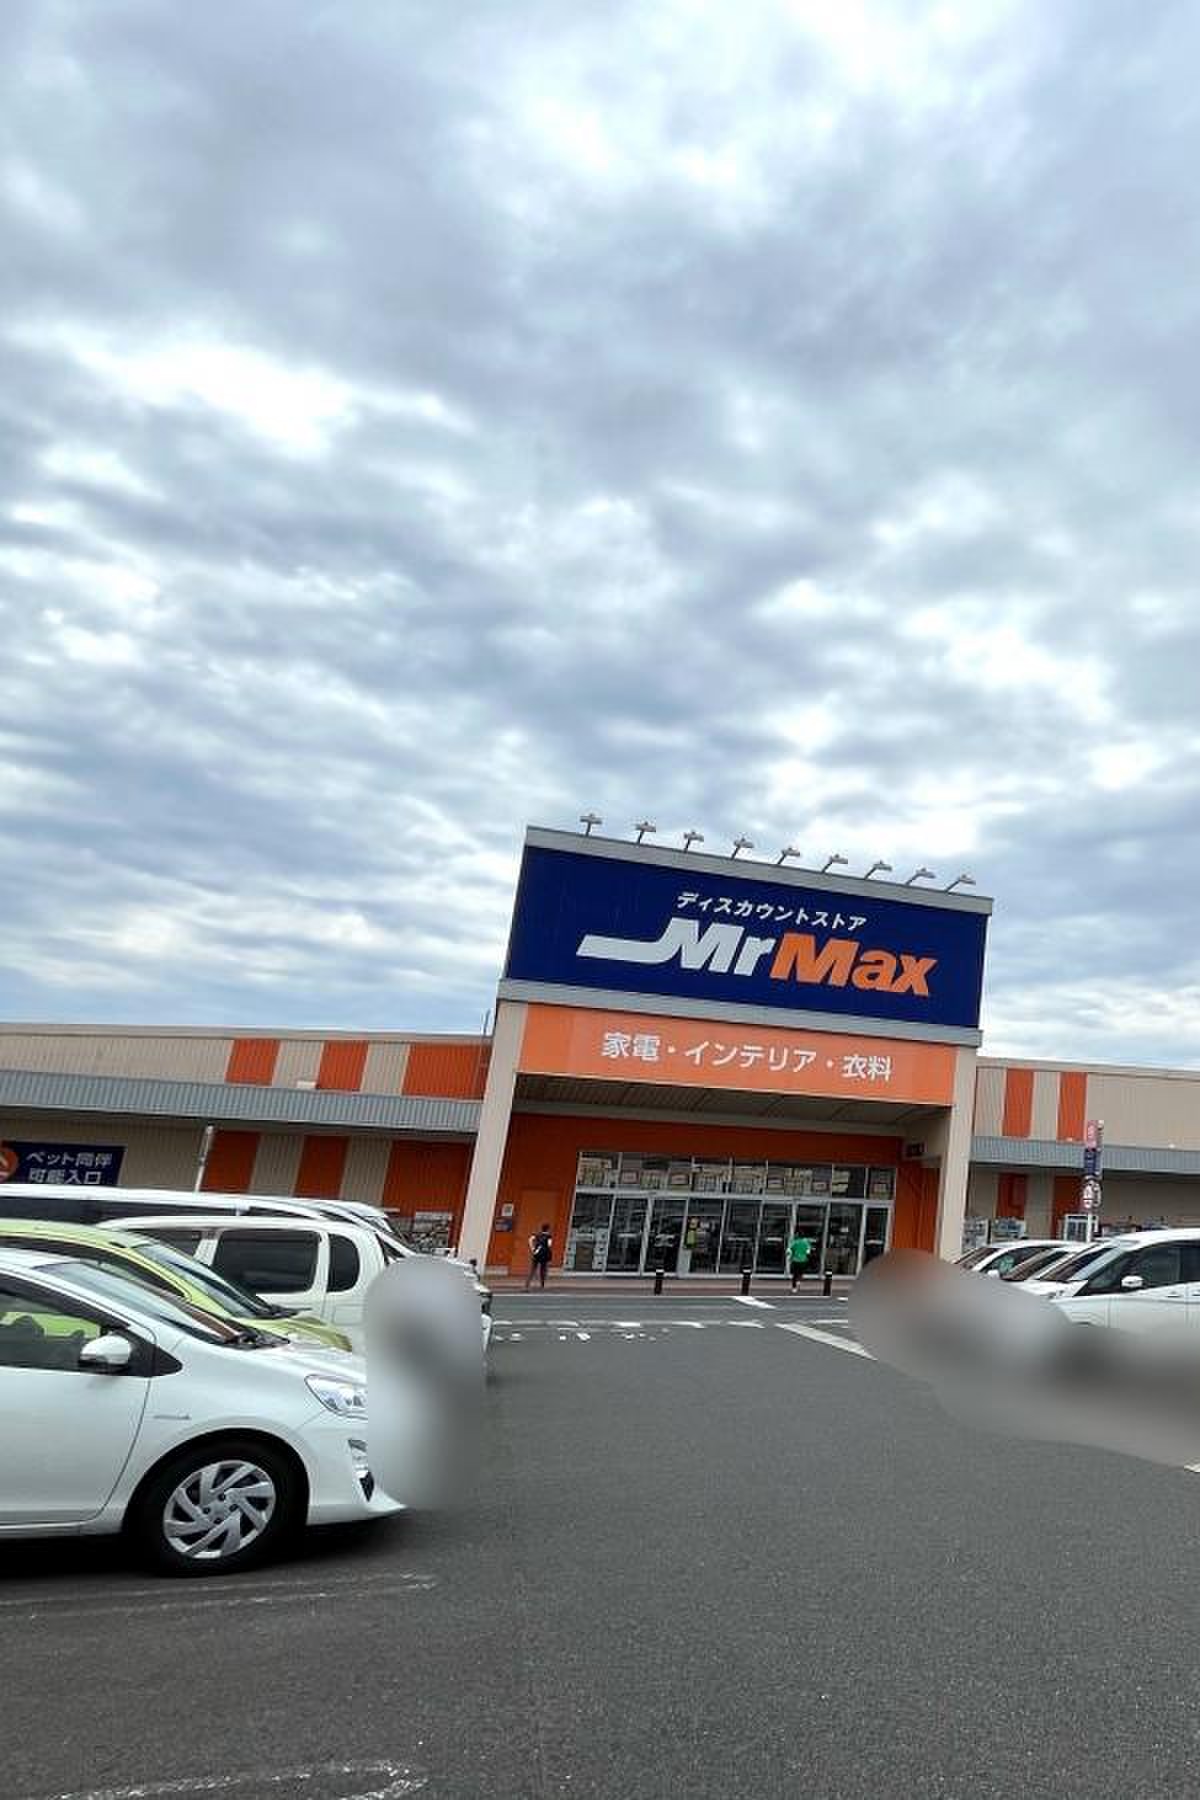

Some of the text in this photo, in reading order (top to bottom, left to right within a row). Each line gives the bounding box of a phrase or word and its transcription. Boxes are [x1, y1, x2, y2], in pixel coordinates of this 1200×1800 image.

[677, 892, 867, 930] ディスカウントストア
[602, 1031, 891, 1081] 家電・インテリア・衣料
